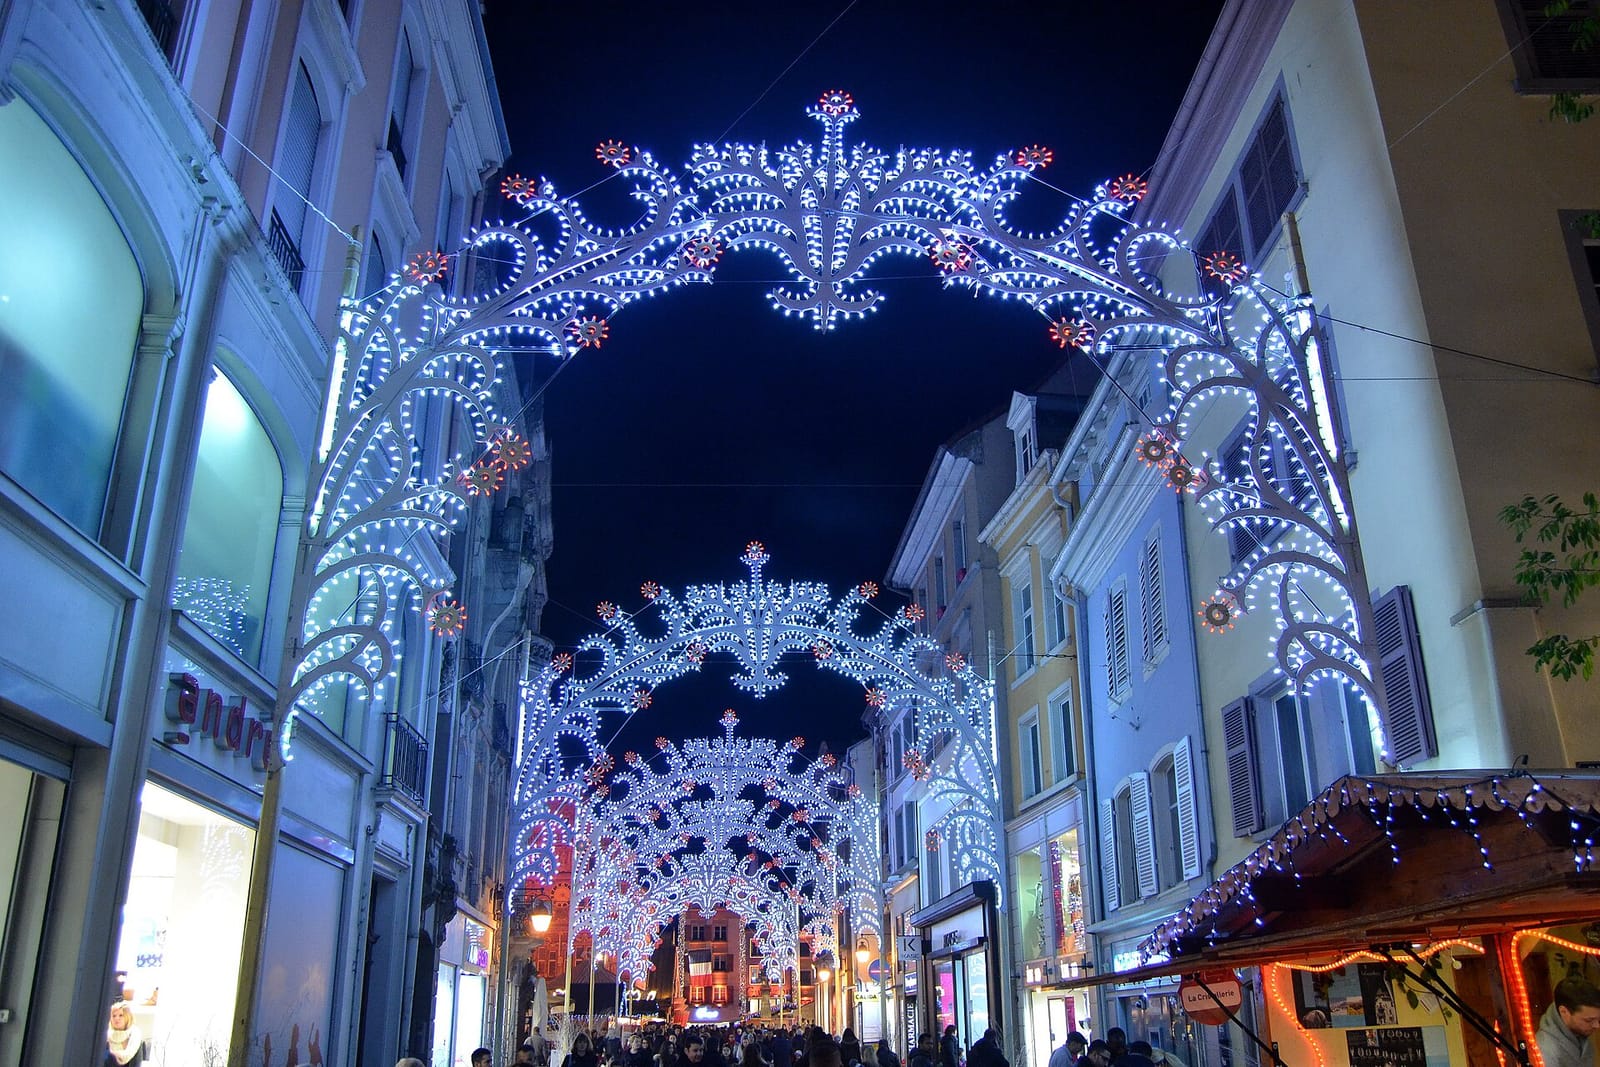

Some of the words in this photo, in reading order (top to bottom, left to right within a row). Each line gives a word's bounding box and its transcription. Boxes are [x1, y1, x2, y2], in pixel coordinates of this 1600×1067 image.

[903, 938, 916, 952] K
[1197, 989, 1235, 1001] Crisllerie
[906, 1003, 915, 1052] HARMACIE
